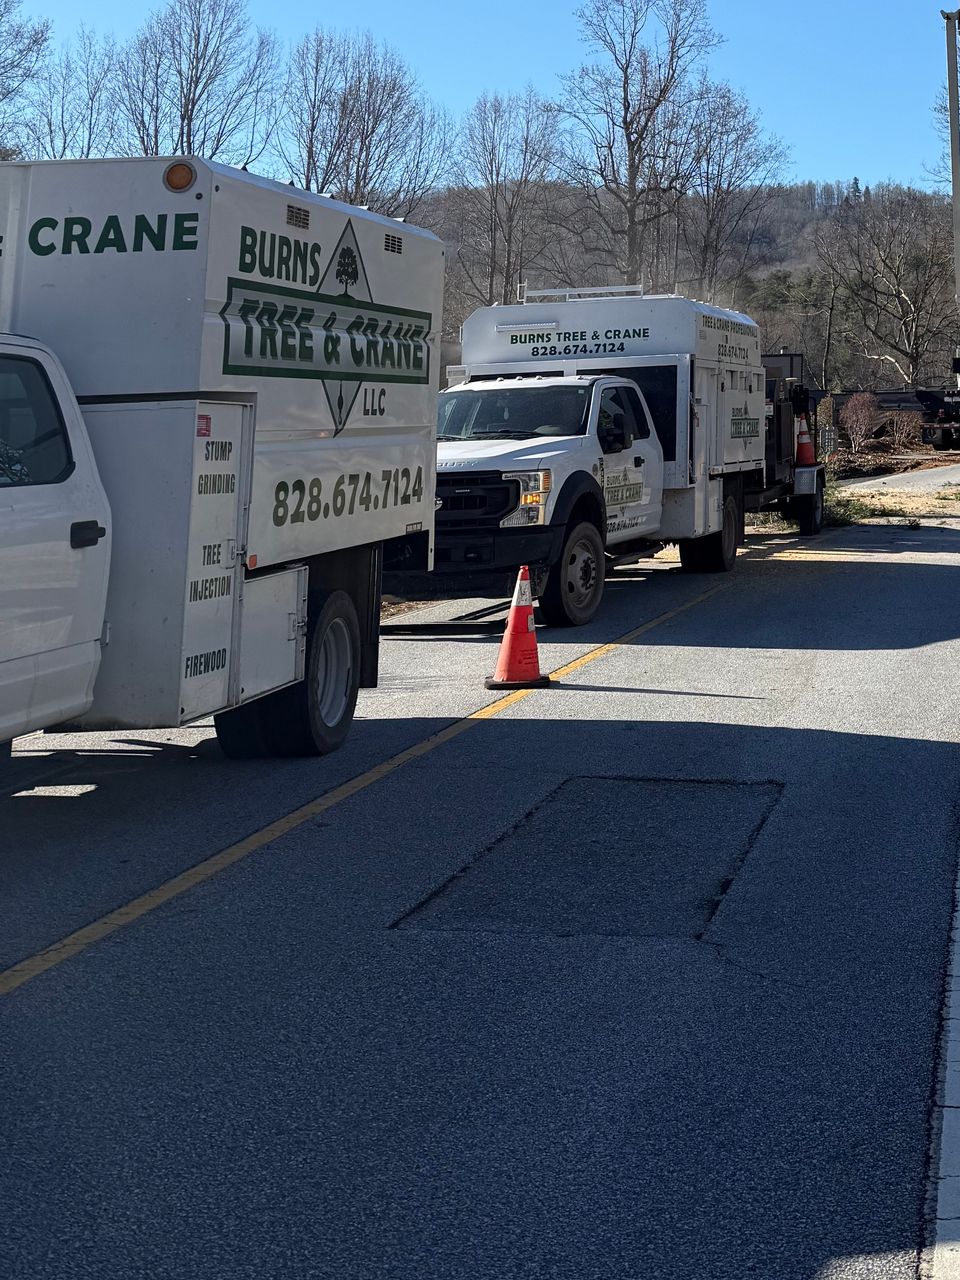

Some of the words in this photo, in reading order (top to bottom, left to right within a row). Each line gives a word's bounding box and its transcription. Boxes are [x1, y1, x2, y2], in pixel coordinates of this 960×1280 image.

[28, 213, 199, 256] CRANE
[238, 226, 321, 287] BURNS
[238, 298, 314, 362] TREE
[322, 311, 341, 365] &
[346, 314, 425, 370] CRANE
[510, 333, 552, 345] BURNS
[556, 331, 587, 342] TREE
[591, 330, 600, 340] &
[604, 328, 650, 339] CRANE
[531, 342, 625, 356] 828.674.7124
[362, 388, 386, 416] LLC
[205, 441, 232, 461] STUMP
[198, 474, 235, 495] GRINDING
[273, 466, 423, 527] 828.674.7124
[203, 544, 221, 566] TREE
[189, 575, 231, 602] INJECTION
[185, 648, 227, 679] FIREWOOD
